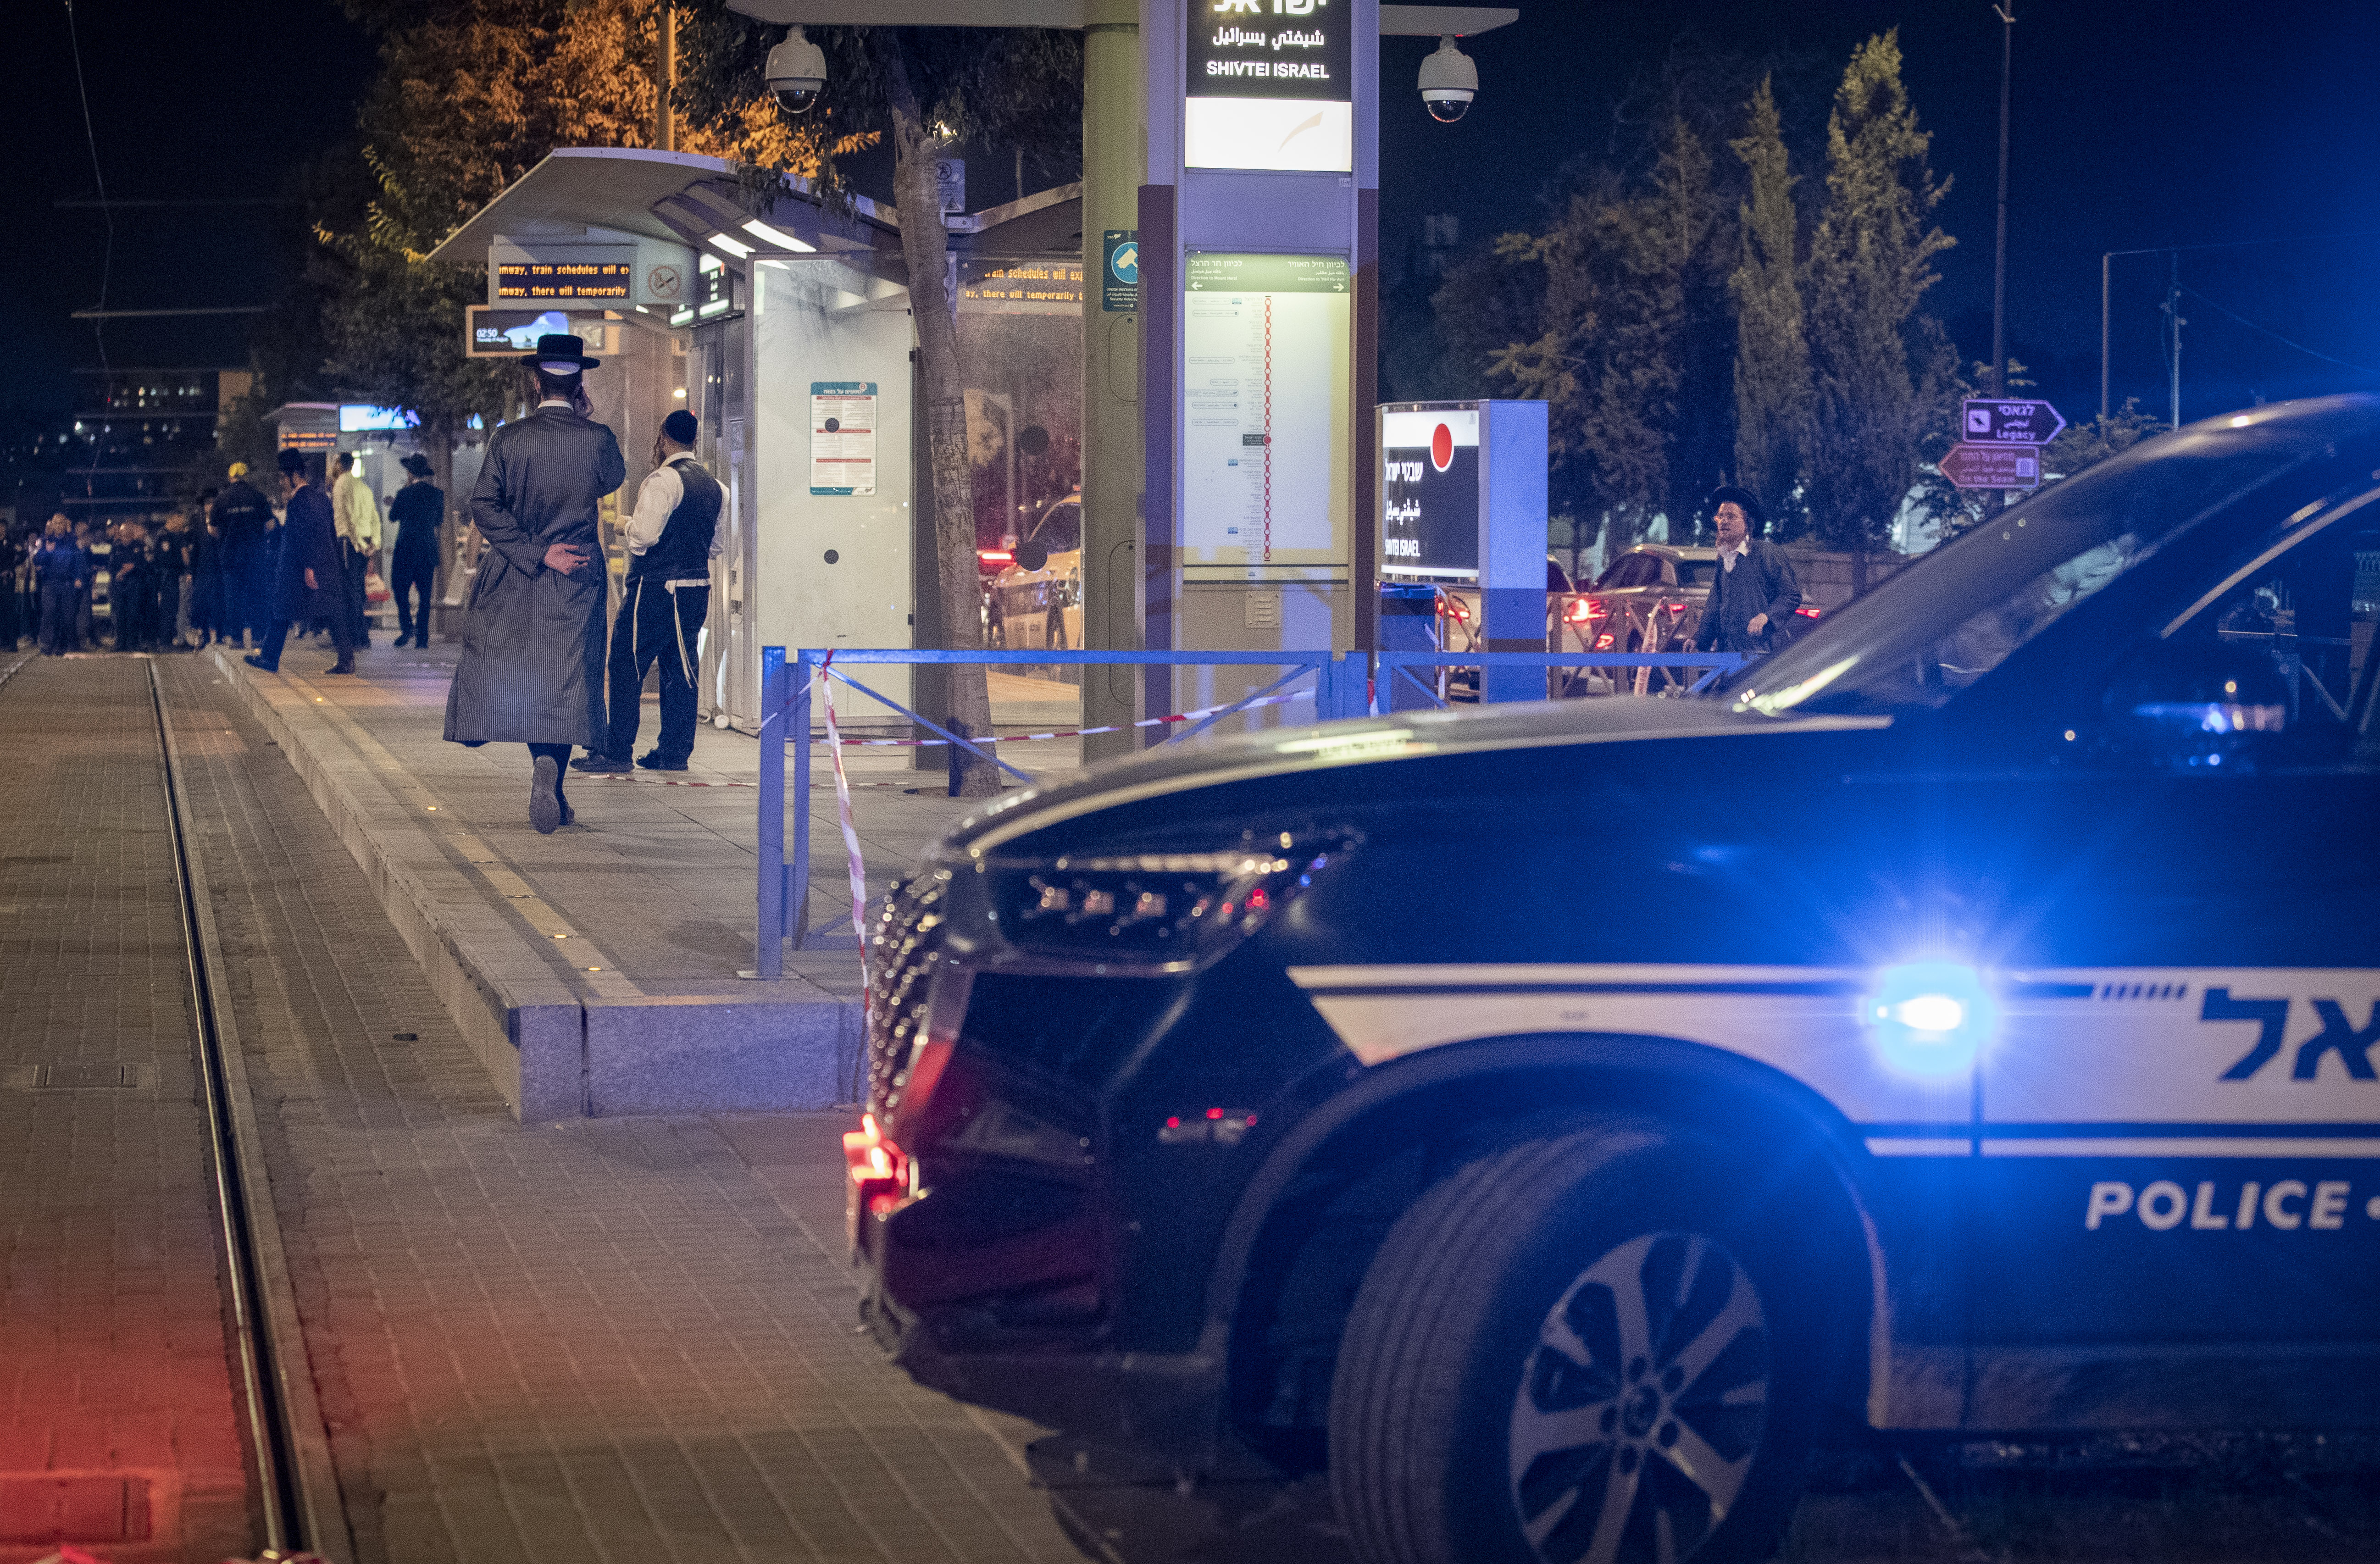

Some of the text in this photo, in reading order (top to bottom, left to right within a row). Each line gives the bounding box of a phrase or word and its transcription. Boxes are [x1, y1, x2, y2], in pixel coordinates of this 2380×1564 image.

[1207, 60, 1330, 78] SHIVTEI ISRAEL
[499, 265, 527, 275] mway,
[532, 265, 553, 275] train
[557, 264, 599, 275] schedules
[602, 265, 616, 275] will
[1224, 260, 1243, 268] לכיוון
[1008, 268, 1049, 279] schedules
[1053, 268, 1065, 280] will
[499, 285, 627, 297] mway, there will temporarily
[983, 289, 1005, 298] there
[1009, 290, 1022, 299] will
[1026, 291, 1074, 301] temporarily
[1998, 404, 2036, 416] לגאסי
[1996, 429, 2036, 440] Legacy
[1400, 539, 1421, 557] ISRAEL
[2085, 1180, 2352, 1231] POLICE
